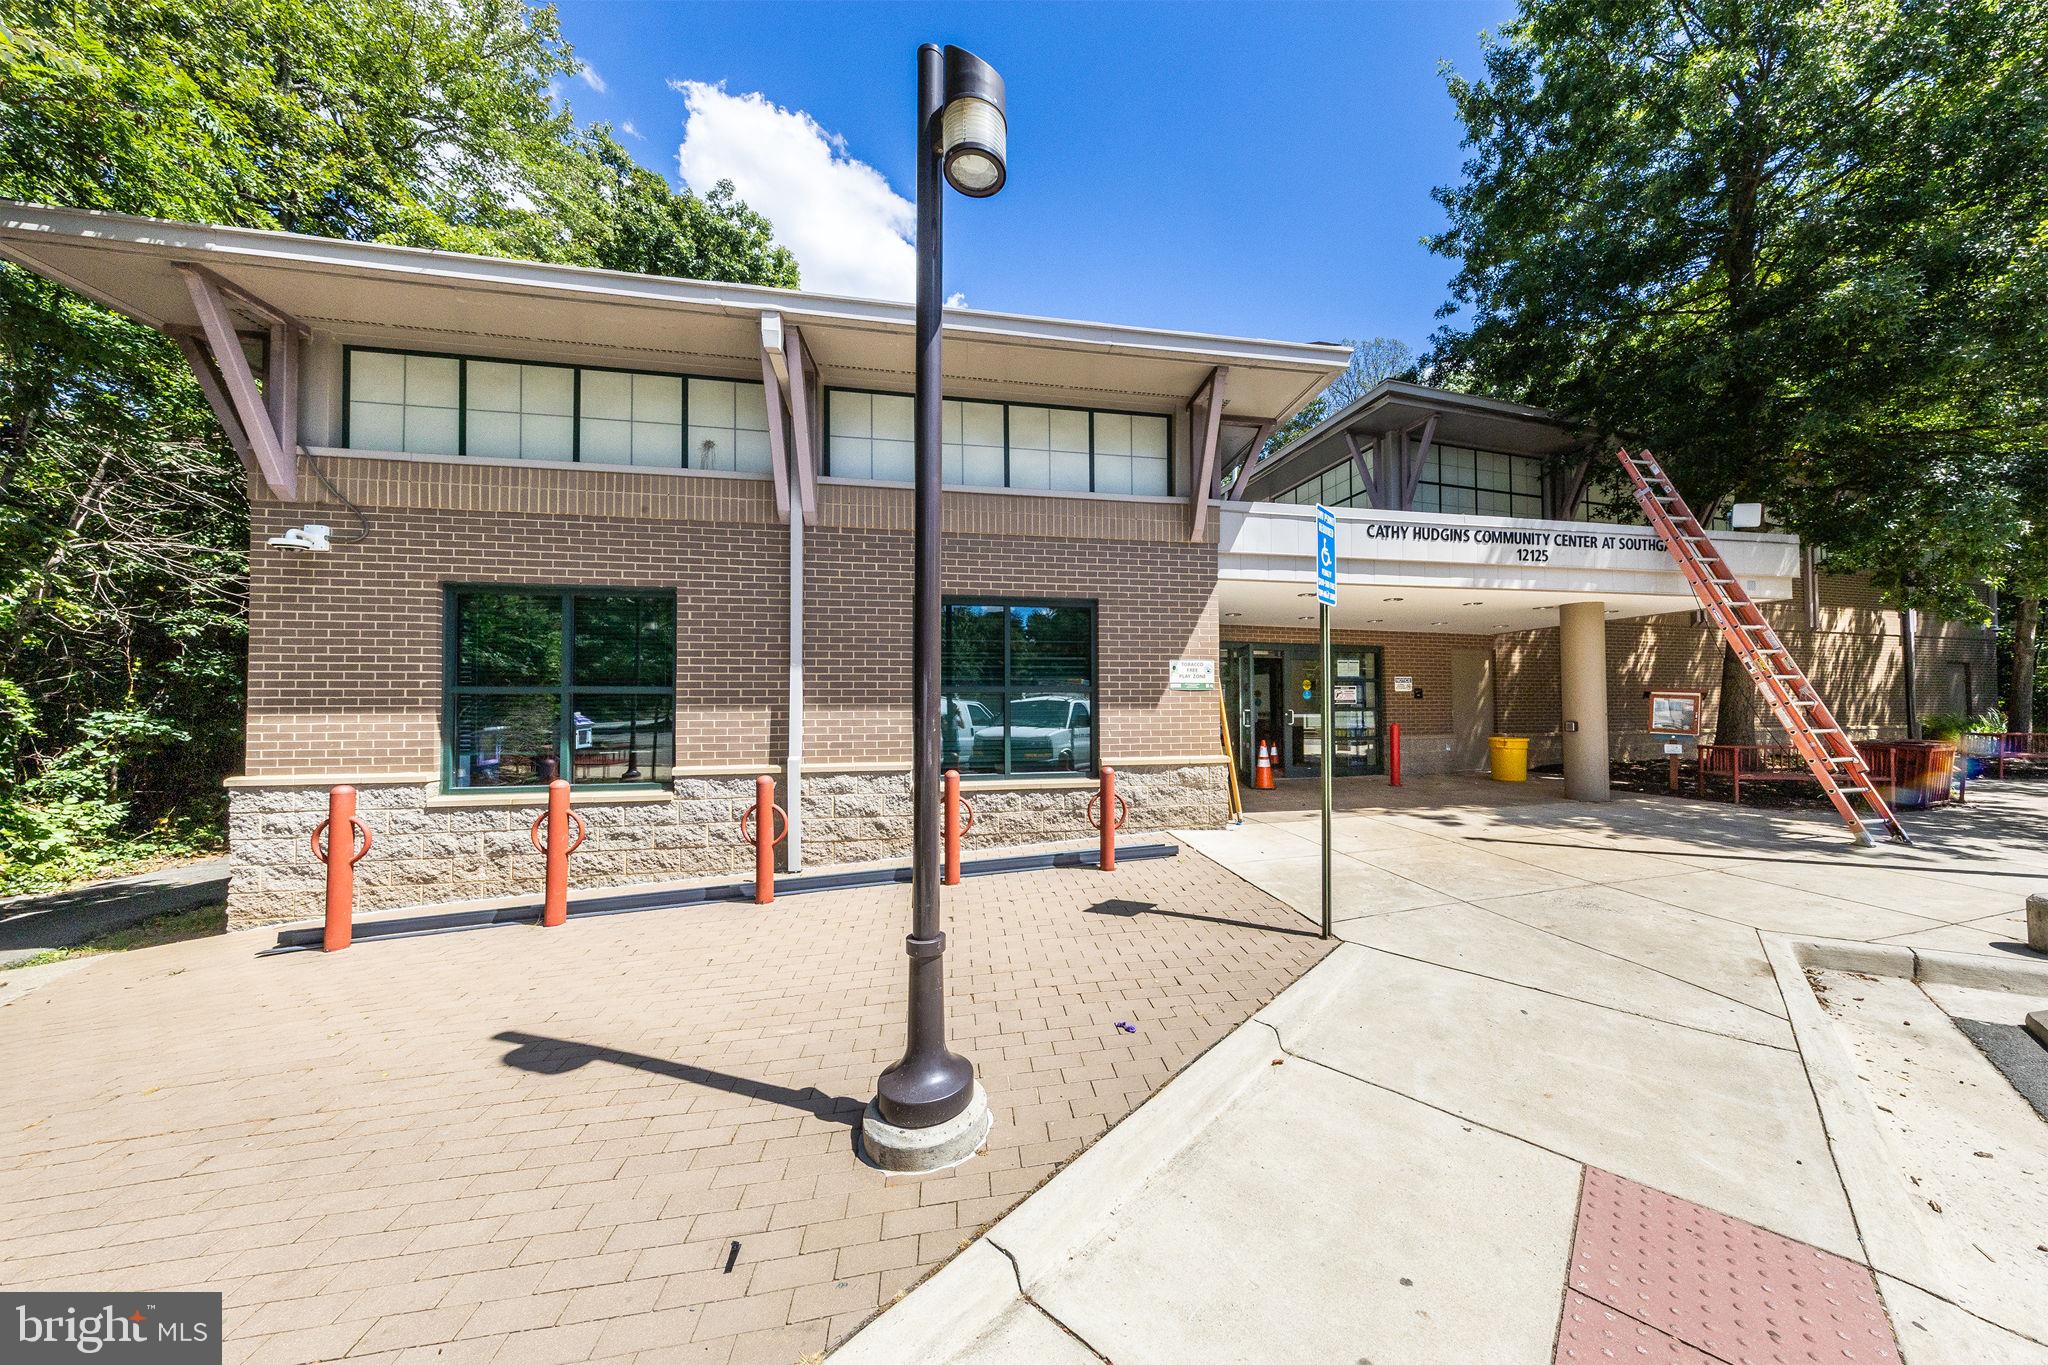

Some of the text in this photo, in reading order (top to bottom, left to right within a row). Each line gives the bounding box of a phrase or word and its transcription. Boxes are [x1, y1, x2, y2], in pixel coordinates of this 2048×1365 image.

[1366, 524, 1409, 539] CATHY
[1413, 526, 1470, 542] HUDGINS
[1474, 530, 1550, 546] COMMUNITY
[1554, 533, 1598, 549] CENTER
[1602, 536, 1616, 549] AT
[1516, 549, 1549, 562] 12125
